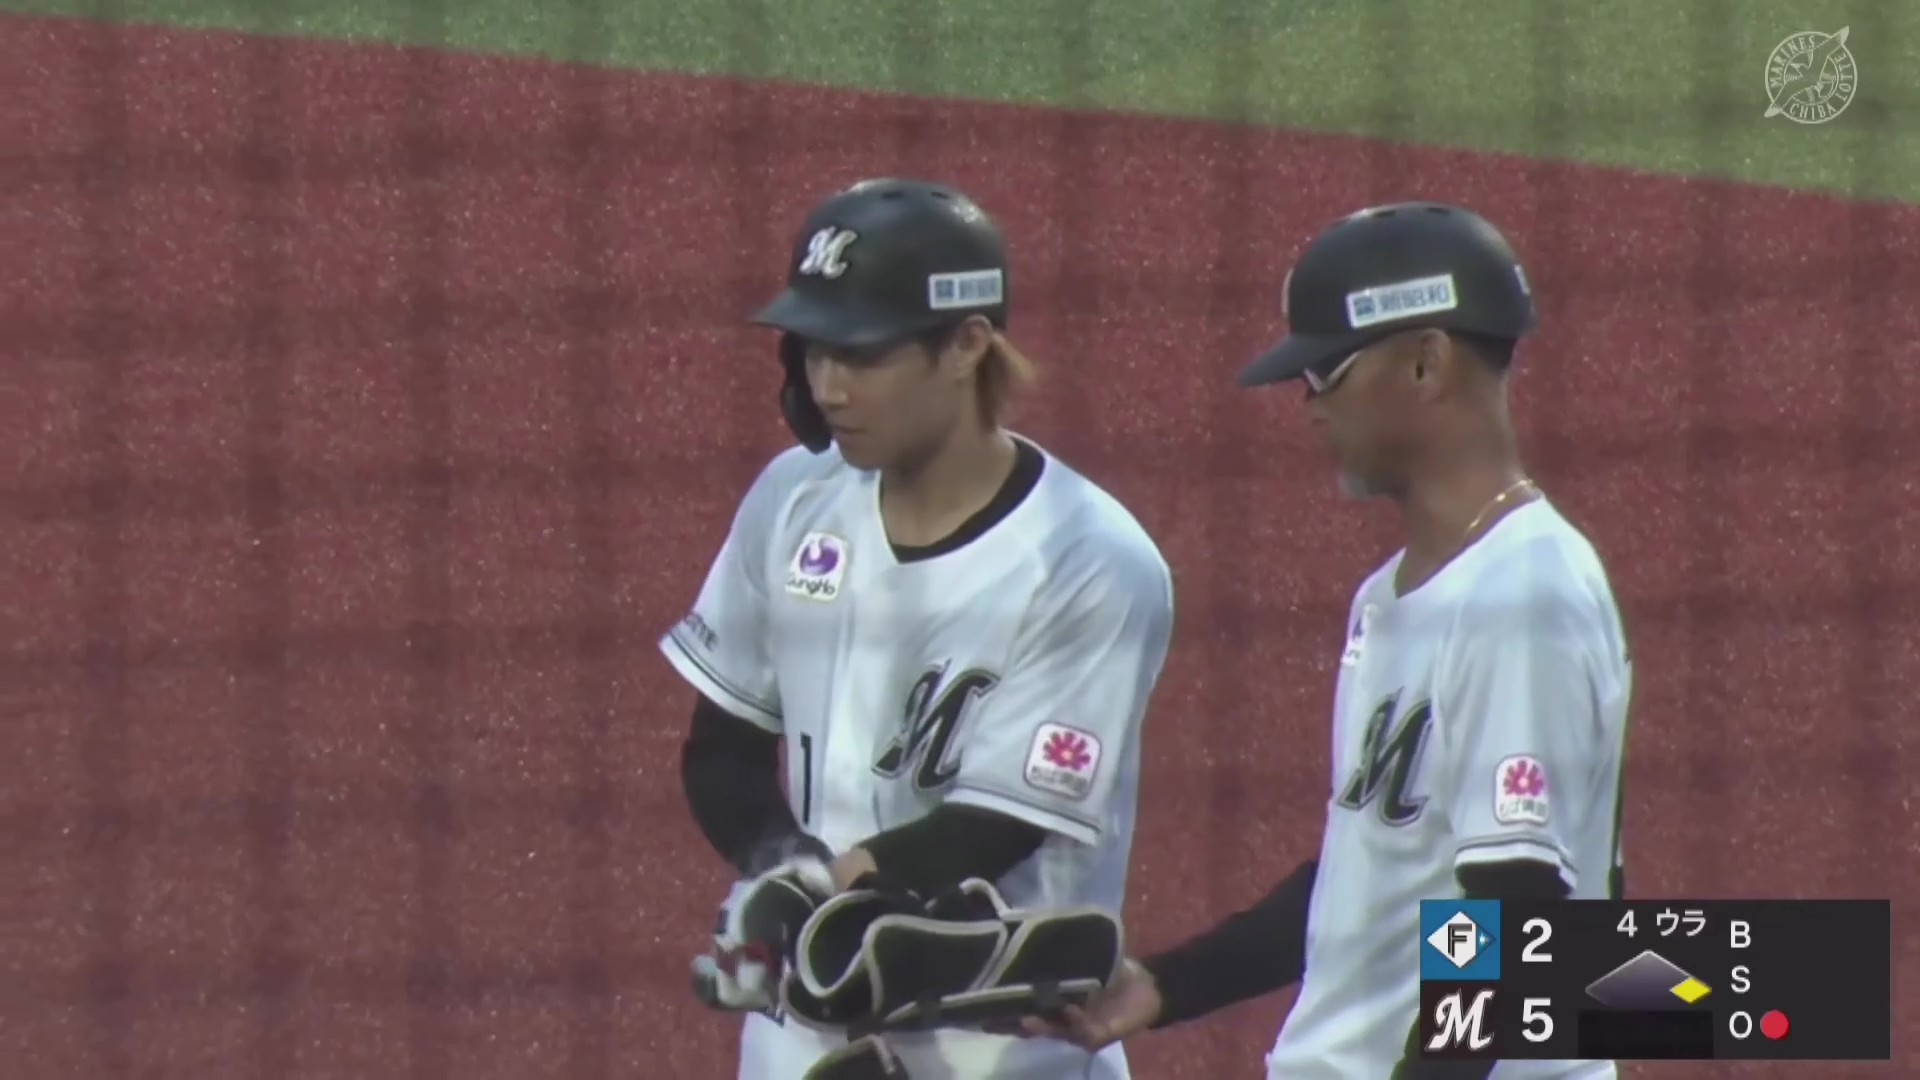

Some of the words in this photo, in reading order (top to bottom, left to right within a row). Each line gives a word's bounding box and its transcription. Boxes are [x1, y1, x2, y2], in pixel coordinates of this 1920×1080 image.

[799, 225, 859, 279] M
[870, 658, 1001, 791] M
[1337, 685, 1433, 828] M
